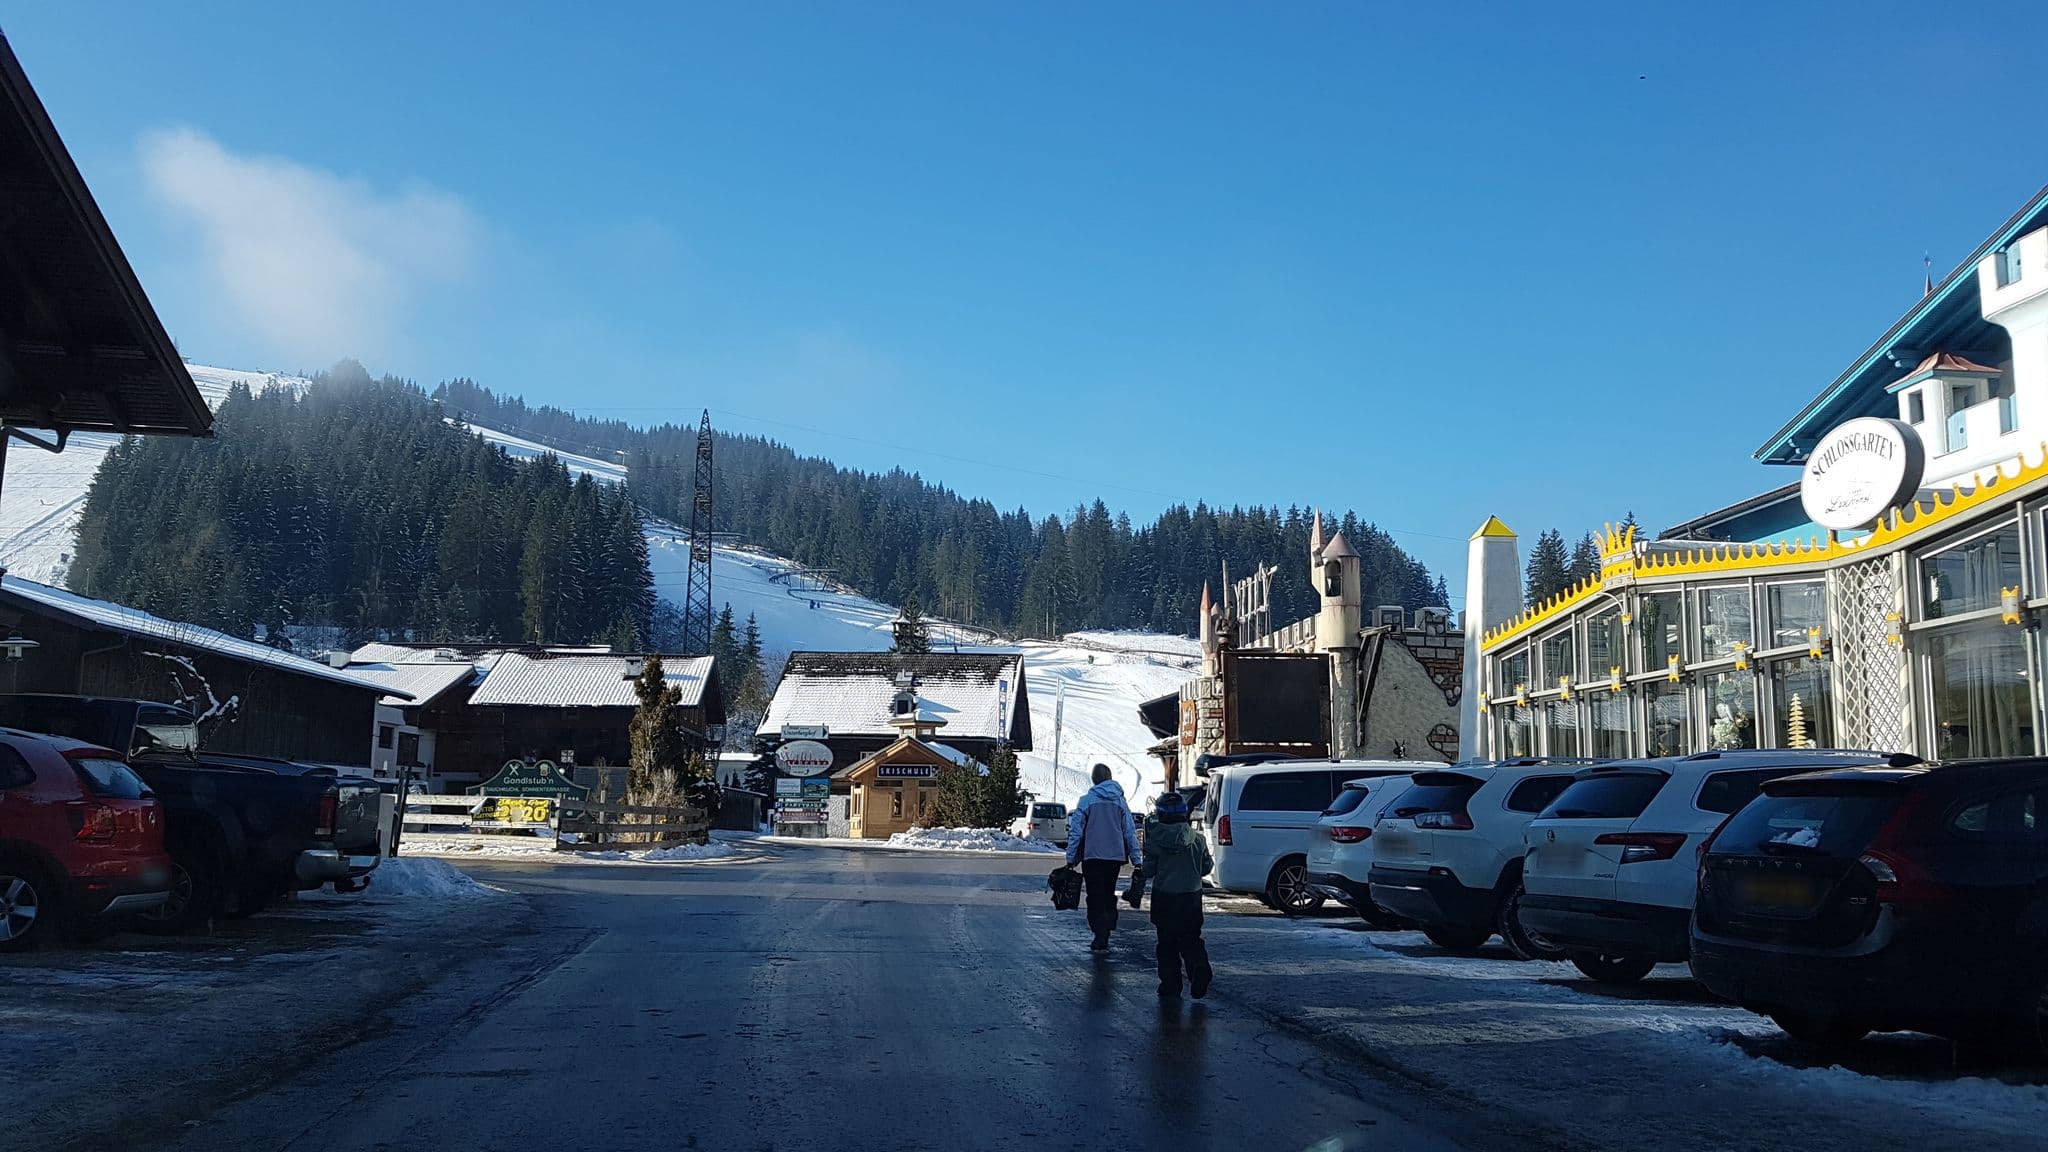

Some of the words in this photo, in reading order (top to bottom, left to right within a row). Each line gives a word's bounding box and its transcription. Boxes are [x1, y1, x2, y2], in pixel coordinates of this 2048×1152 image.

[1811, 432, 1897, 482] SCHLOSSGARTEN
[880, 767, 930, 775] SKISCHULE
[1727, 857, 1803, 871] VOLVO
